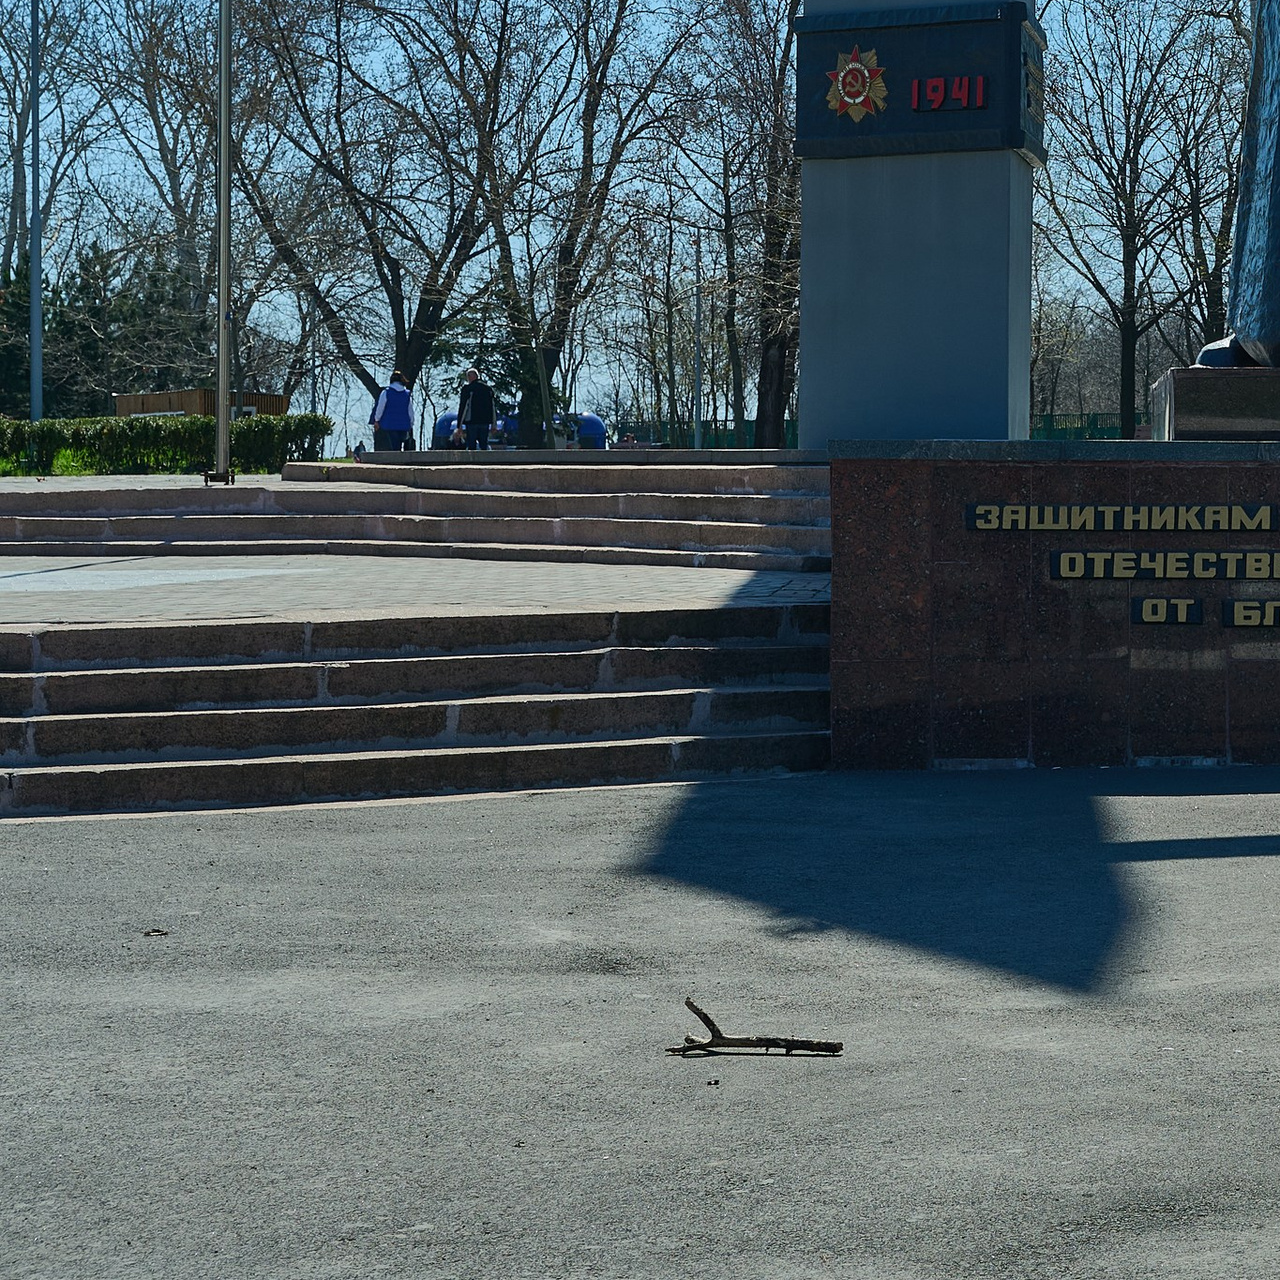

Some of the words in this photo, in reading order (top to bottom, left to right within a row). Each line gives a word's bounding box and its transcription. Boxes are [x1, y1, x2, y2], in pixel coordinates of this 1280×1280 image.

[912, 76, 983, 109] 1941
[977, 507, 1270, 529] ЗАЩИТНИКАМ
[1143, 600, 1192, 621] ОТ
